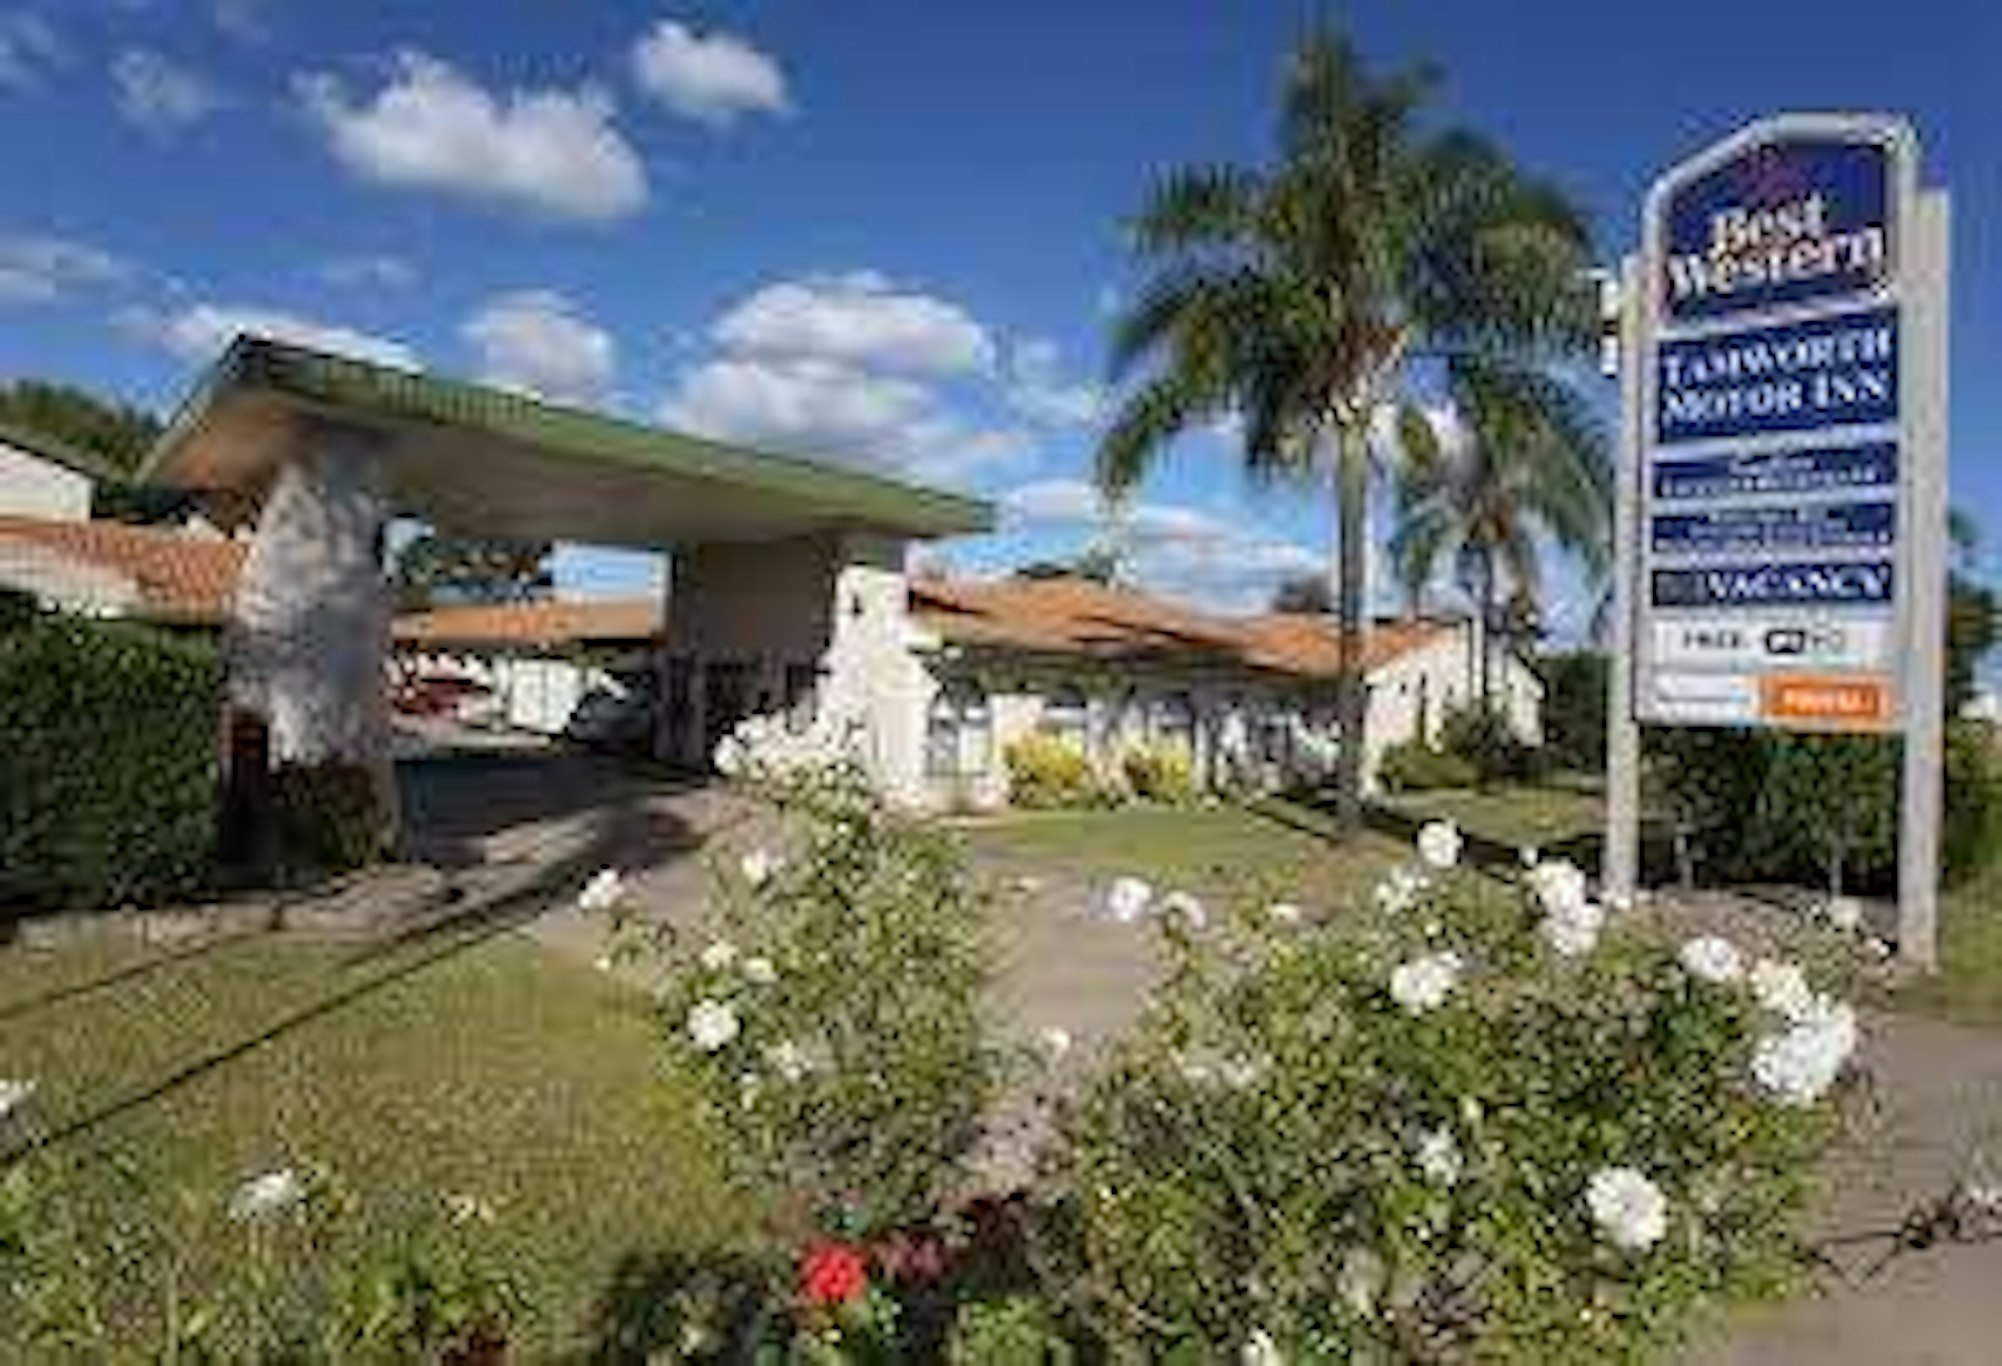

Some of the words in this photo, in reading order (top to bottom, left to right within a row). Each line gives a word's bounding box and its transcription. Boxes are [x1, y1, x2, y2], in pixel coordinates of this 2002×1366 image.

[1708, 190, 1825, 258] Best
[1666, 226, 1886, 298] Western
[1664, 327, 1890, 388] TAMWORTH
[1661, 382, 1803, 426] MOTOR
[1813, 369, 1890, 409] INN
[1706, 566, 1891, 600] VACANCY
